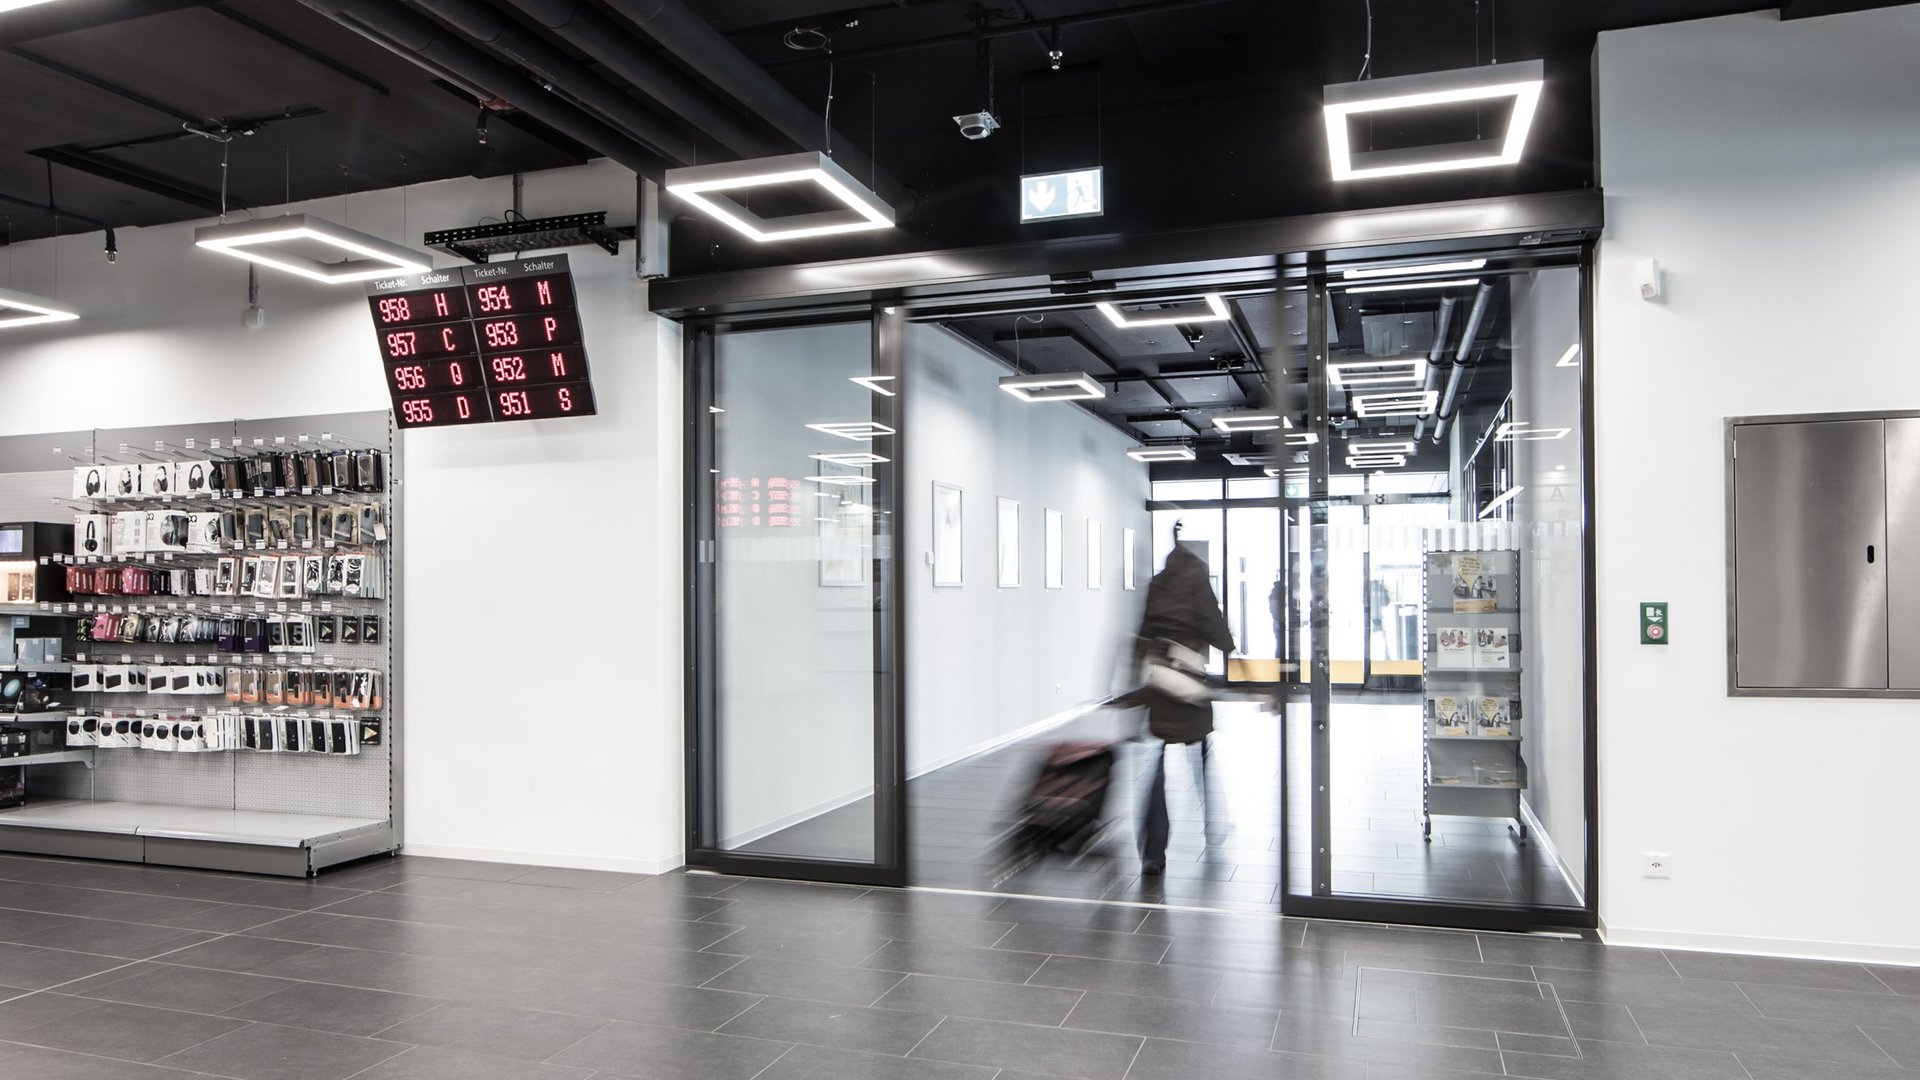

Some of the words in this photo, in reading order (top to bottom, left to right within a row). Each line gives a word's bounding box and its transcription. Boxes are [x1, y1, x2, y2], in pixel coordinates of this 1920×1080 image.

[374, 278, 408, 290] Ticket-Nr.
[420, 274, 450, 285] Schalter
[473, 266, 509, 278] Ticket-Nr.
[523, 260, 554, 272] Schalter
[379, 298, 411, 323] 958
[434, 293, 449, 317] H
[478, 286, 512, 312] 954
[537, 280, 552, 306] M
[387, 332, 417, 357] 957
[442, 328, 456, 351] C
[485, 321, 519, 347] 953
[544, 317, 557, 341] P
[394, 366, 426, 390] 956
[450, 362, 463, 386] Q
[492, 357, 526, 382] 952
[551, 353, 566, 377] M
[402, 400, 433, 423] 955
[457, 396, 470, 419] D
[500, 392, 532, 416] 951
[558, 388, 572, 411] S
[292, 625, 303, 644] 5
